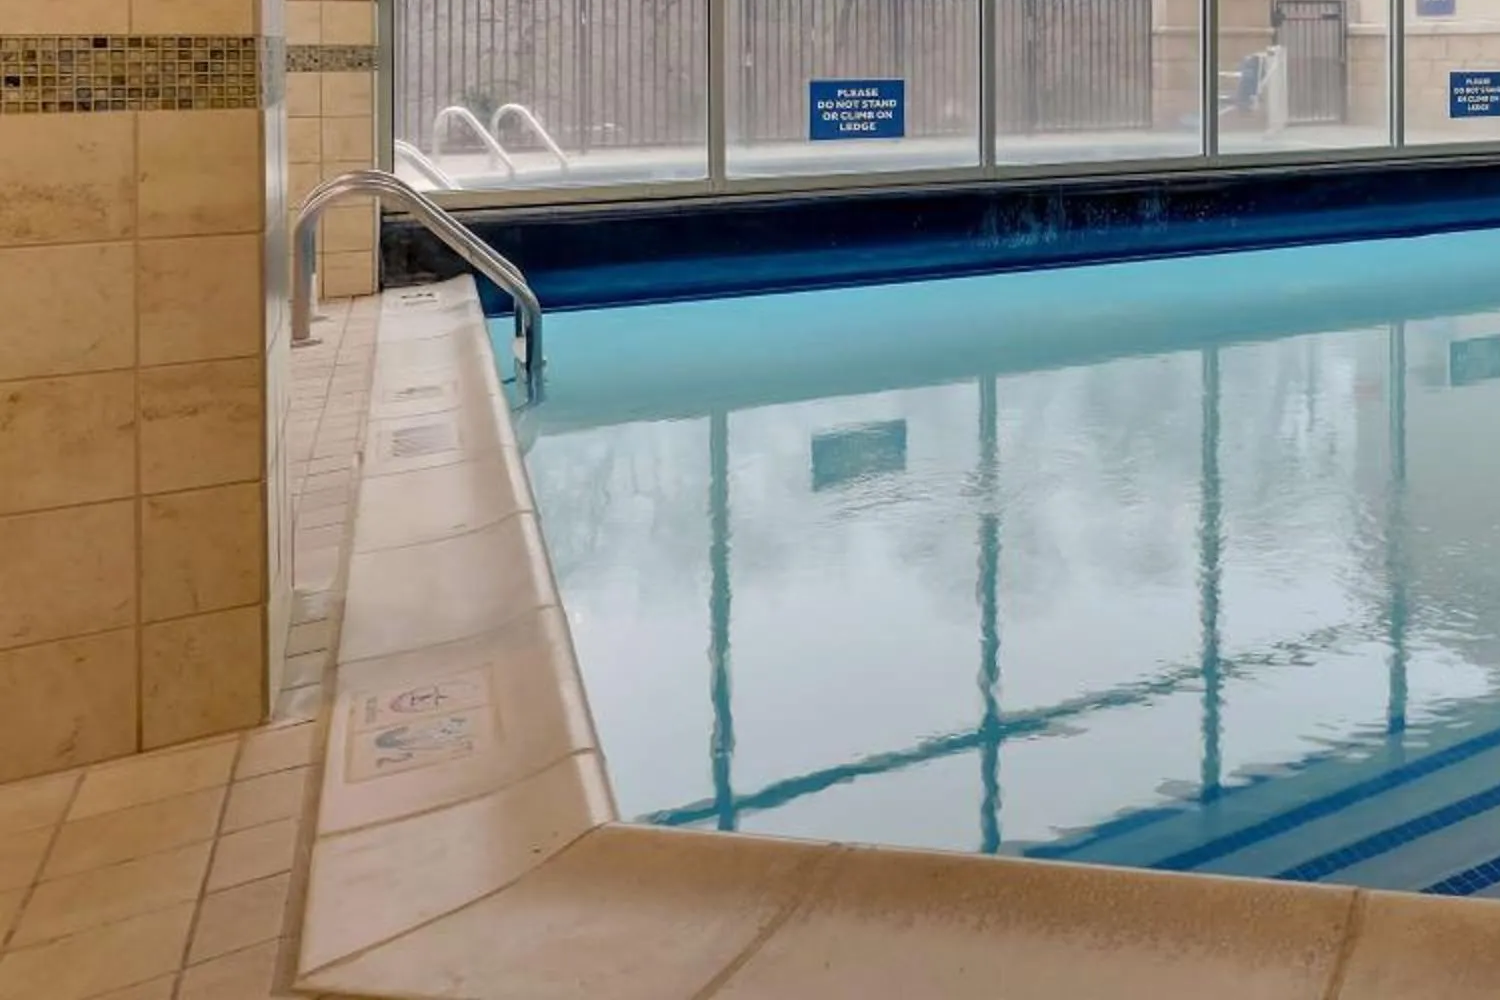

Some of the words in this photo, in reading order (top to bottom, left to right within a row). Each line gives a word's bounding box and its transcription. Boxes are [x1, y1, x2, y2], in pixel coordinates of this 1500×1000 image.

[837, 88, 878, 97] PLEASE
[818, 101, 834, 109] DO
[836, 100, 859, 109] NOT
[862, 99, 897, 108] STAND
[822, 112, 839, 120] OR
[840, 111, 874, 120] CLIMB
[876, 111, 893, 119] ON
[839, 122, 877, 131] LEDGE
